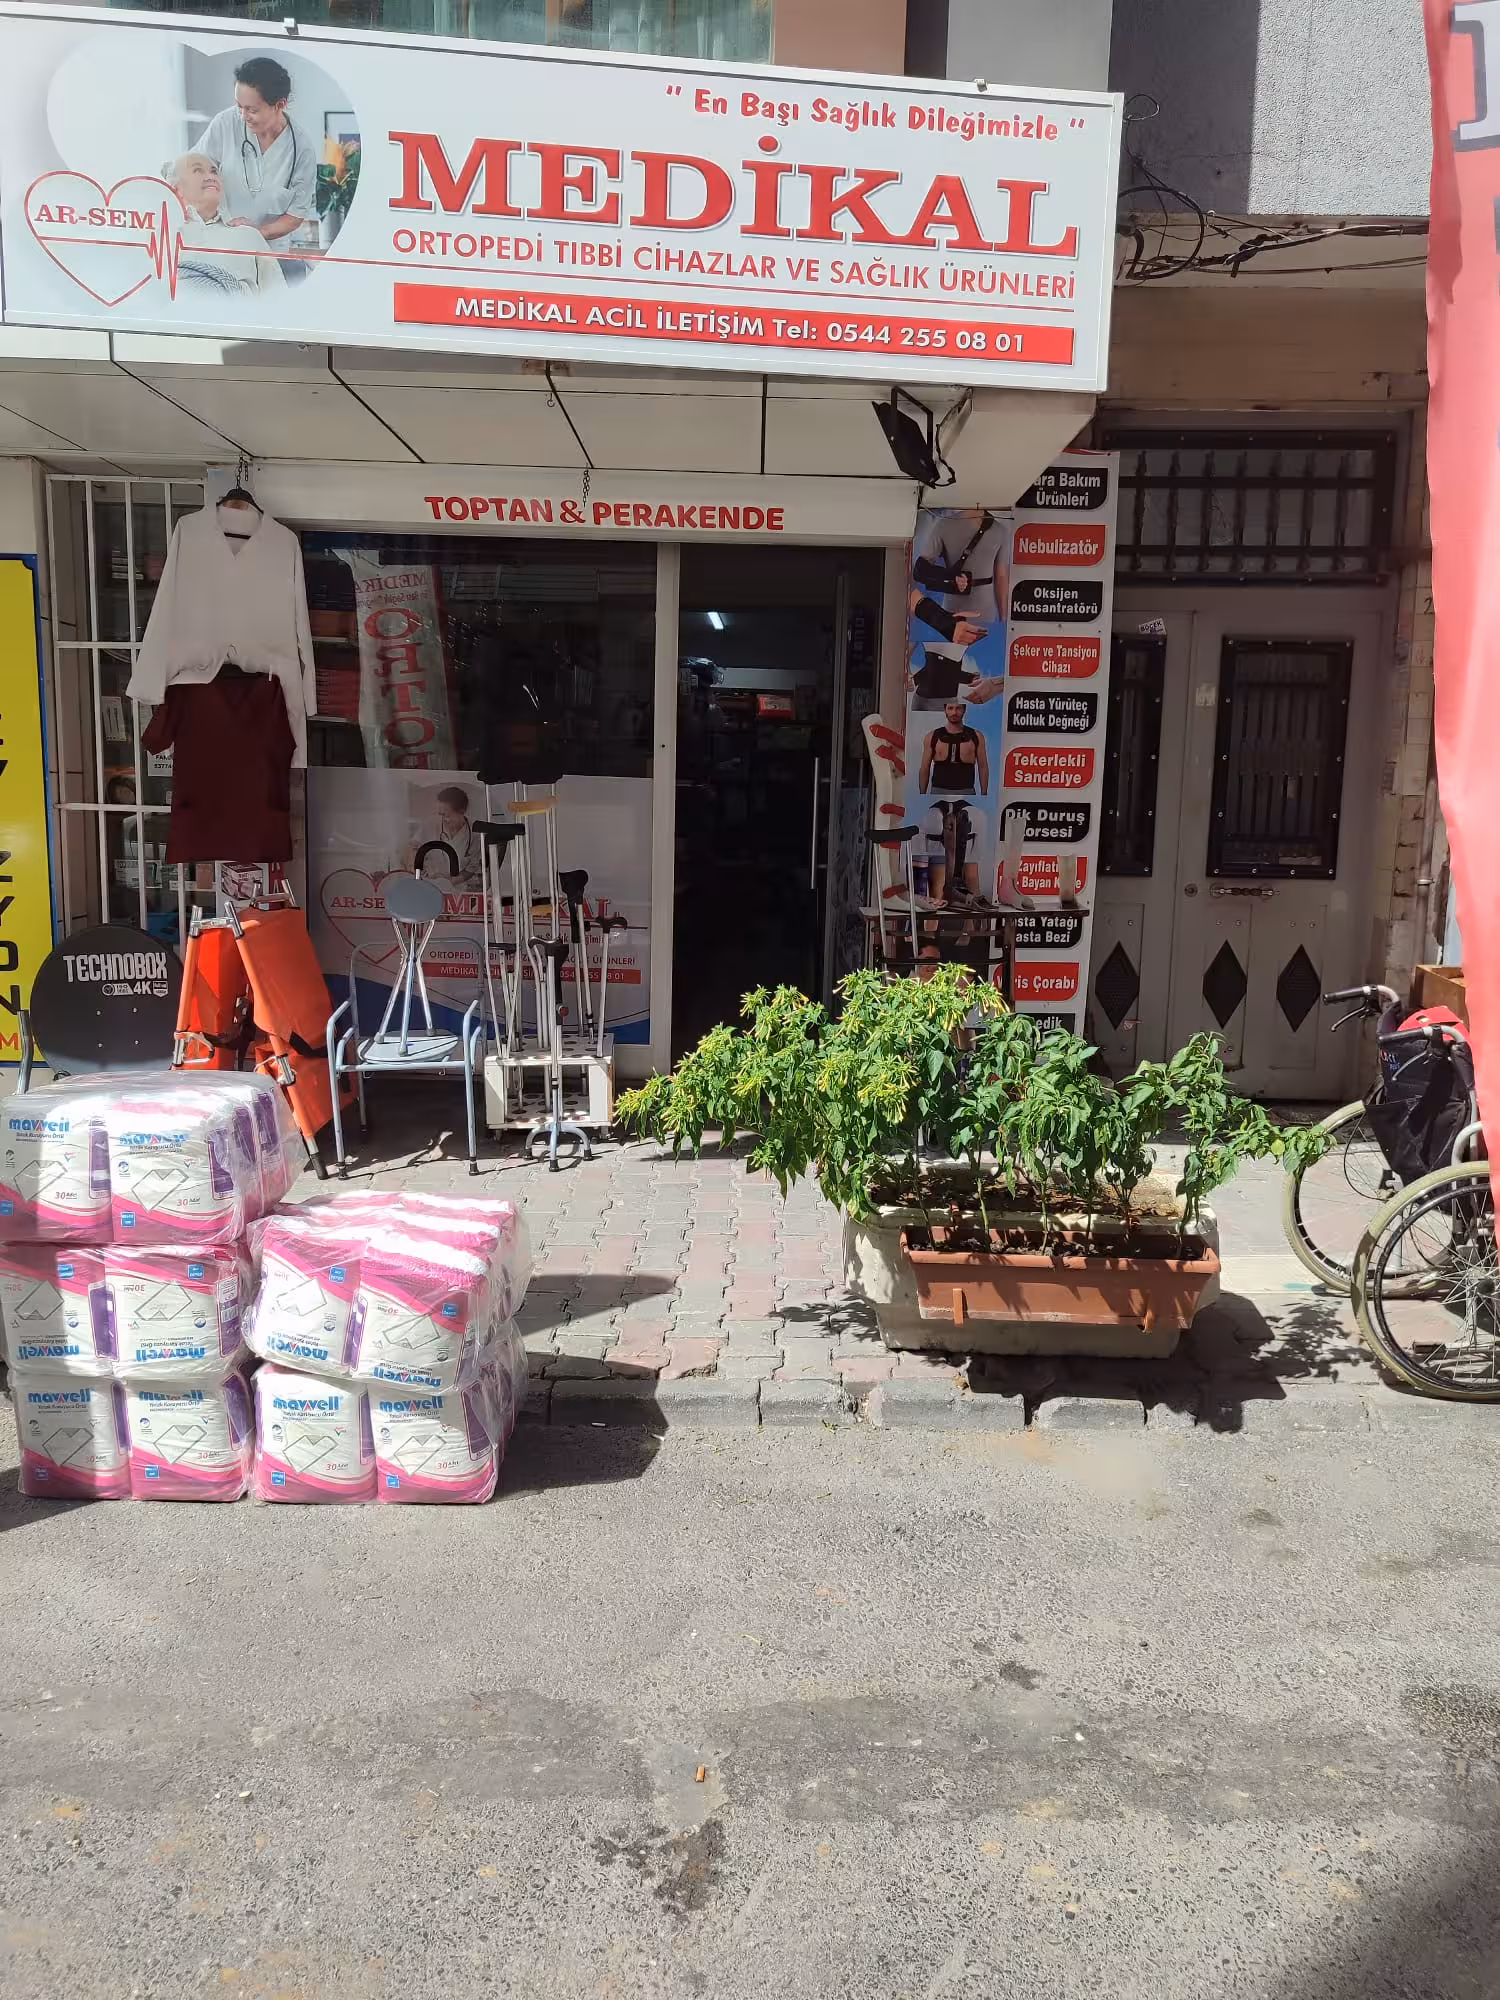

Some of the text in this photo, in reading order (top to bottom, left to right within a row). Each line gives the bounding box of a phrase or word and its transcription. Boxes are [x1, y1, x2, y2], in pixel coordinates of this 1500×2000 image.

[695, 88, 728, 115] En
[741, 92, 799, 127] Başı
[812, 97, 897, 133] Sağlık
[908, 104, 1059, 142] Dileğimizle
[388, 131, 1081, 259] MEDİKAL
[34, 203, 156, 230] AR-SEM
[393, 228, 1075, 300] ORTOPEDİ TIBBİ CİHAZLAR VE SAĞLIK ÜRÜNLERİ
[455, 296, 1025, 353] MEDİKAL ACİL İLETİŞİM Tel: 0544 255 08 01
[1034, 472, 1101, 488] ara Bakım
[1036, 487, 1089, 507] Ürünleri
[424, 495, 785, 532] TOPTAN & PERAKENDE
[1018, 537, 1099, 555] Nebulizatör
[1033, 587, 1079, 601] Oksijen
[1013, 601, 1098, 615] Konsantratörü
[1013, 643, 1098, 660] Şeker ve Tansiyon
[1041, 660, 1071, 674] Cihazı
[1015, 696, 1089, 714] Hasta Yürüteç
[1012, 713, 1089, 730] Koltuk Değneği
[1012, 752, 1086, 767] Tekerlekli
[1014, 769, 1082, 787] Sandalye
[1005, 808, 1085, 826] Dik Duruş
[1023, 825, 1073, 838] orsesi
[1021, 876, 1051, 891] Bayan
[330, 896, 386, 909] AR-SE
[1015, 931, 1070, 944] asta Bezi
[62, 952, 168, 983] TECHNOBOX
[133, 980, 153, 995] 4K
[1033, 975, 1075, 993] Çorabı
[176, 1198, 189, 1207] 30
[325, 1463, 337, 1471] 30
[436, 1461, 449, 1470] 30
